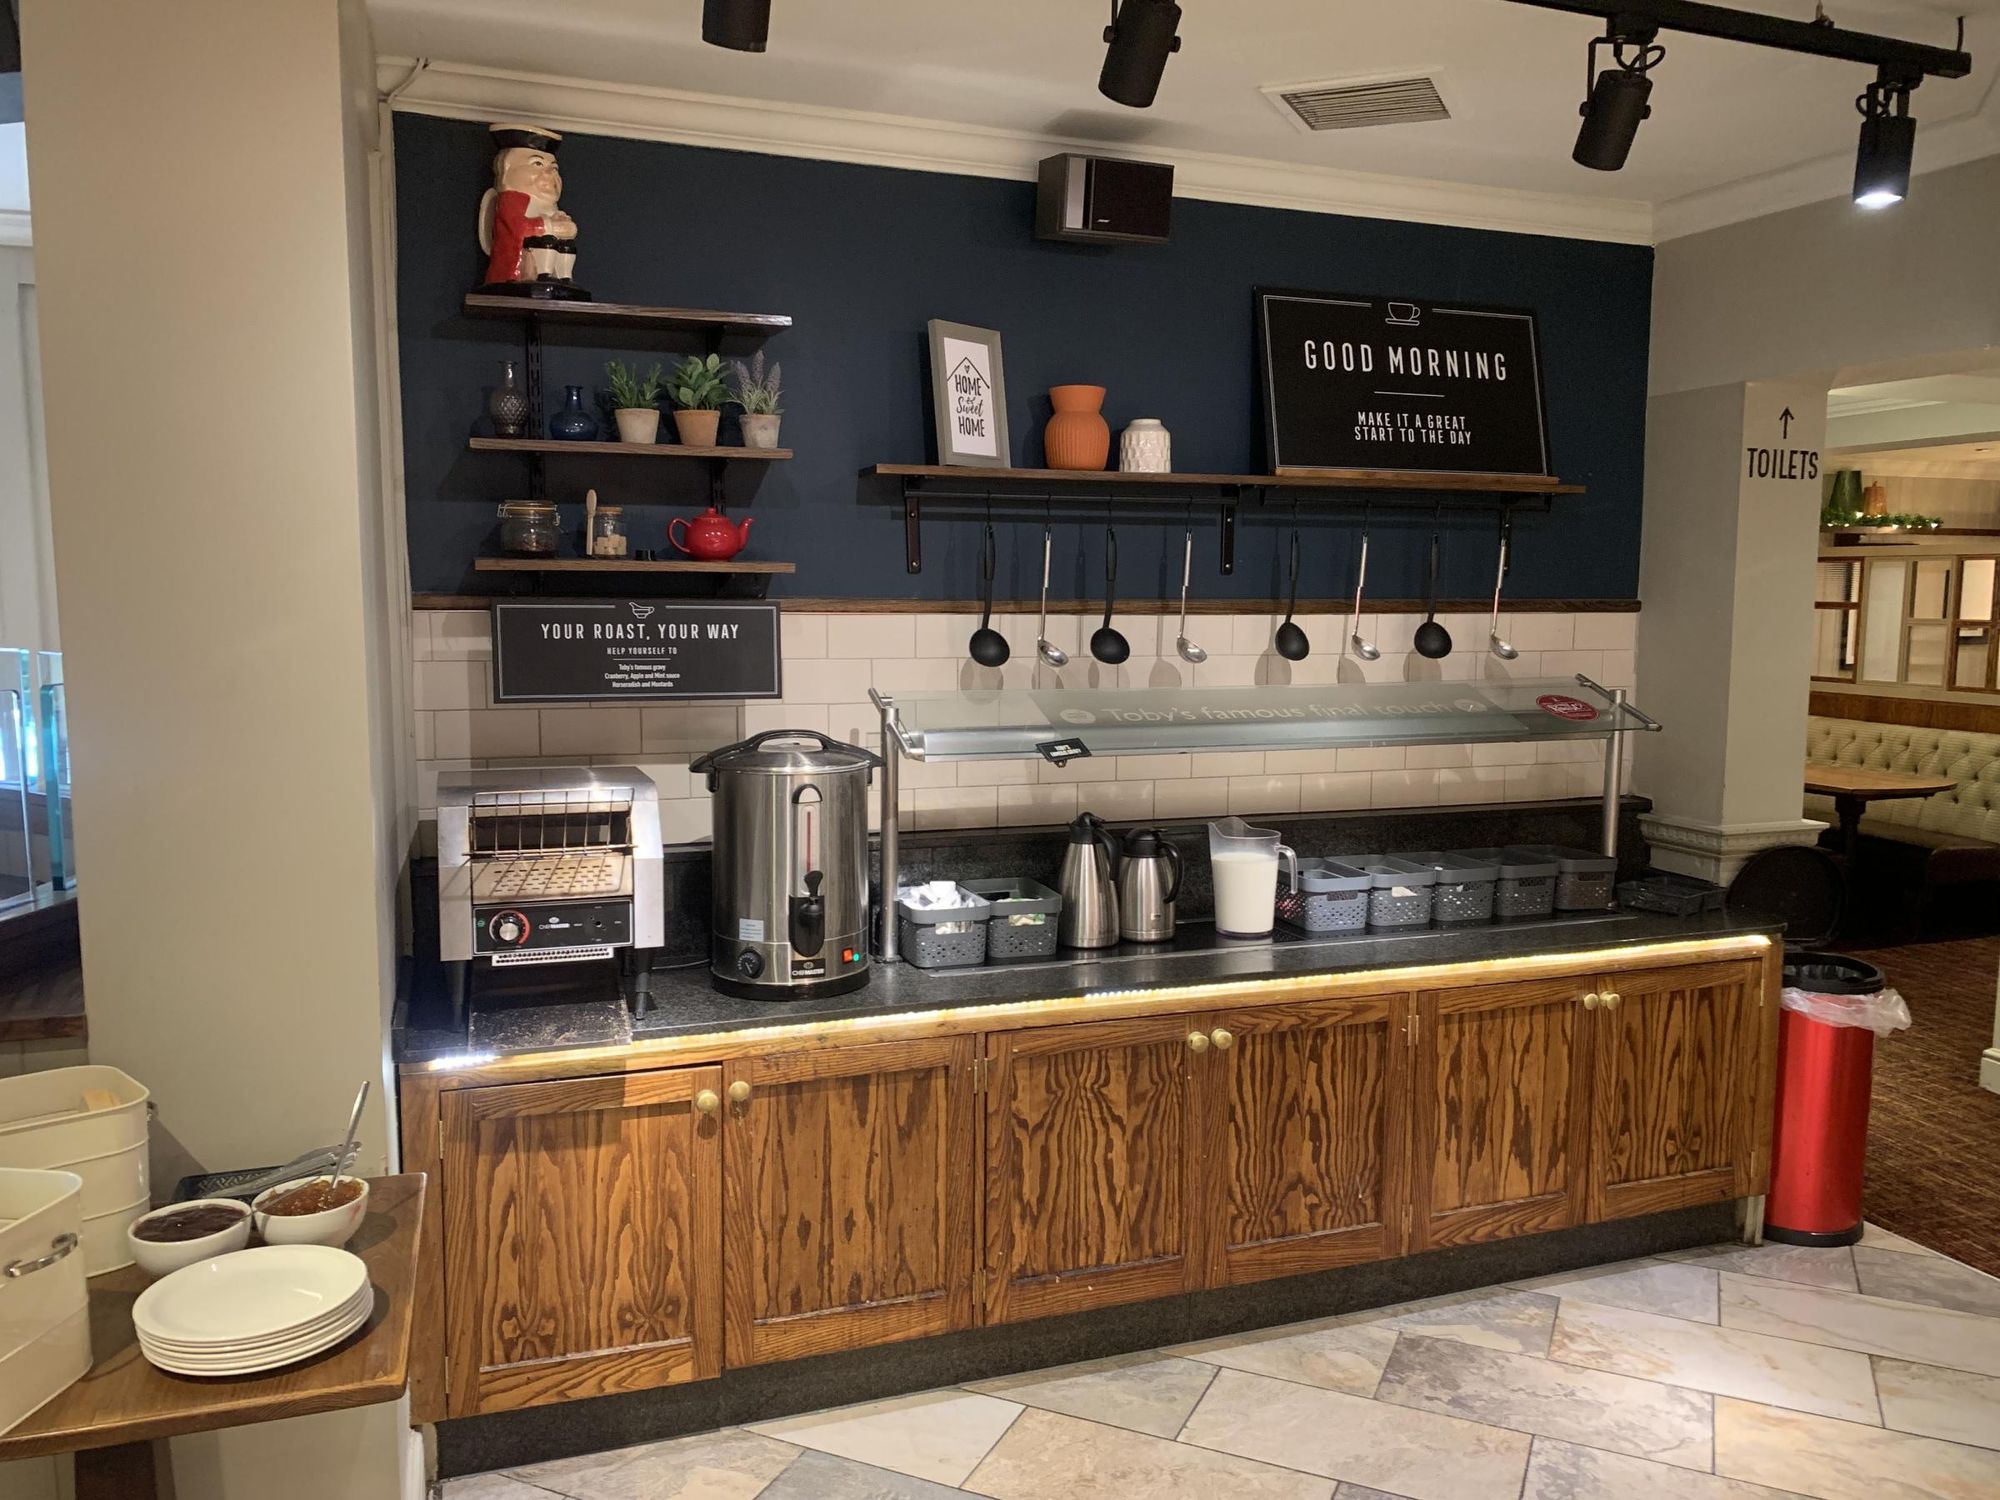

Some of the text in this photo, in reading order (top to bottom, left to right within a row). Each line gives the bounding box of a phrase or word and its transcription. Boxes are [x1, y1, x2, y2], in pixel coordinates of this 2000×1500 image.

[1304, 339, 1507, 381] GOOD MORNING
[955, 374, 982, 396] HOME
[958, 416, 985, 437] HOME
[1357, 411, 1465, 430] MAKE IT A GREAT
[1354, 426, 1472, 445] START TO THE DAY
[1747, 447, 1819, 480] TOILETS
[541, 623, 739, 641] YOUR ROAST, YOUR WAY
[606, 647, 678, 655] HELP YOURSELF TO
[1101, 706, 1195, 723] Toby's
[1201, 705, 1305, 721] famous
[1309, 703, 1369, 718] final
[1374, 701, 1452, 715] touch
